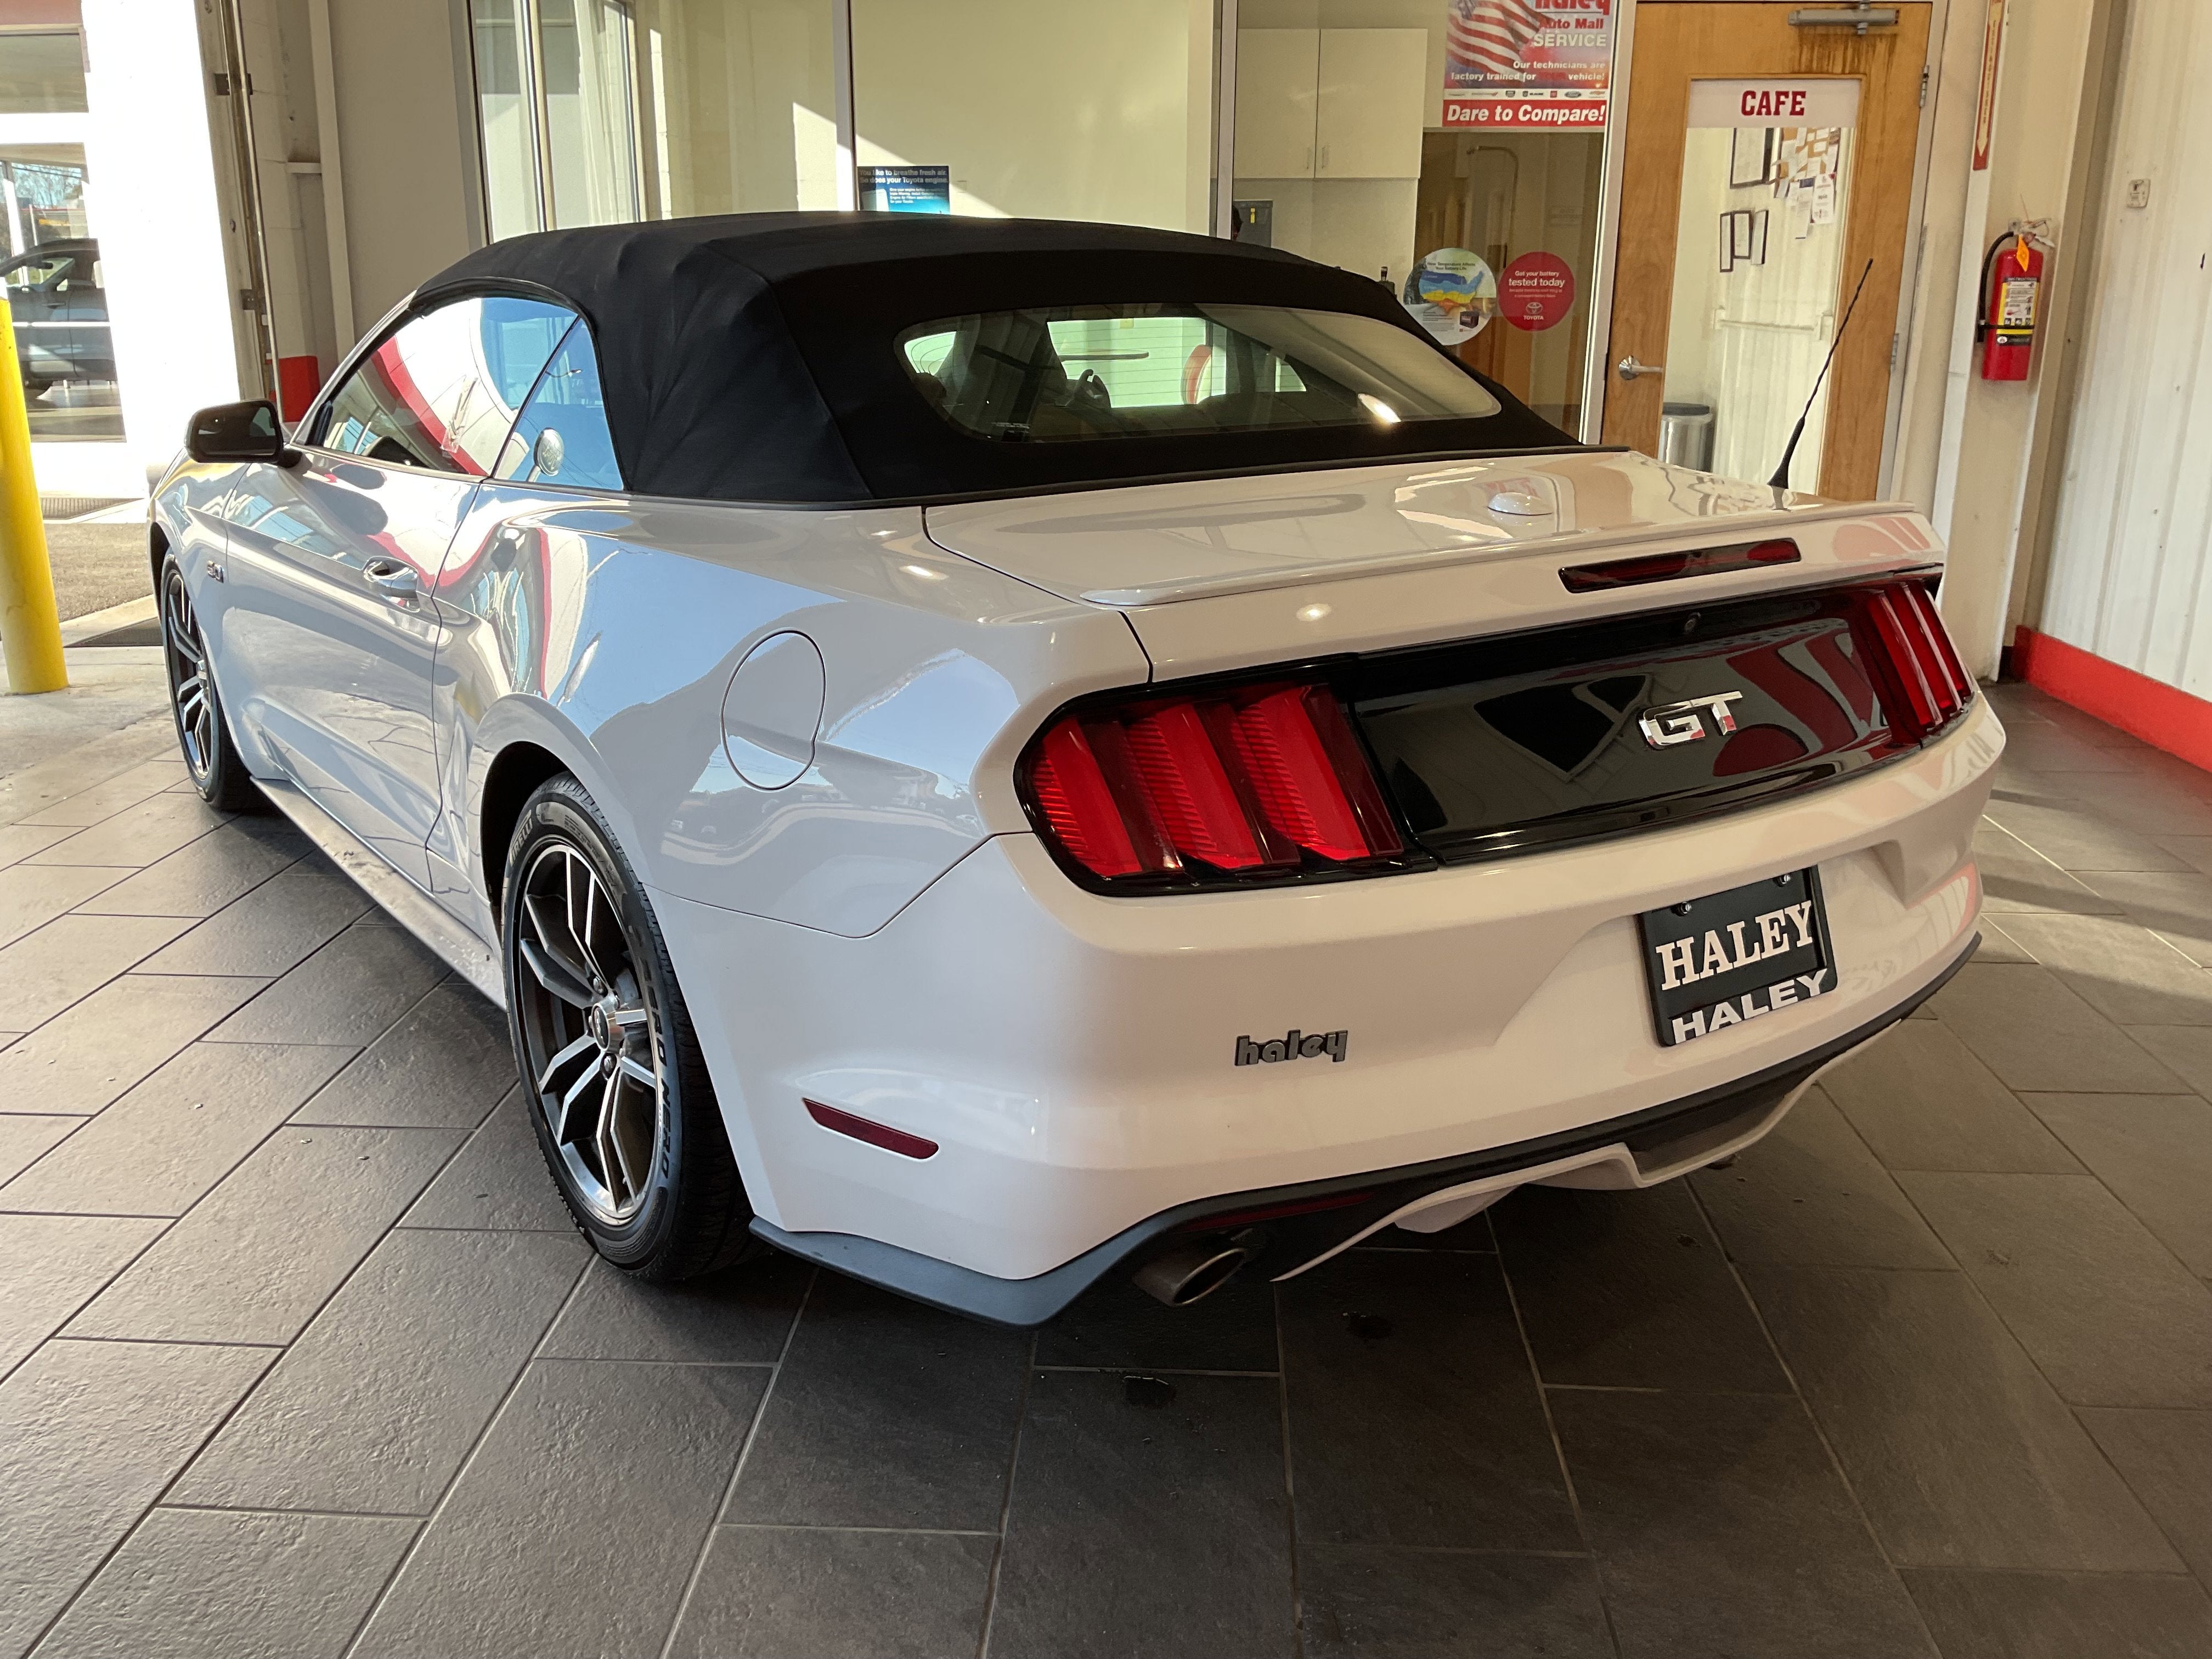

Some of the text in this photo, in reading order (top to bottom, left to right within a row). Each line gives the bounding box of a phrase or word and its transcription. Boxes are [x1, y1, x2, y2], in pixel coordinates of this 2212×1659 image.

[1575, 18, 1604, 29] Mall
[1533, 33, 1607, 47] SERVICE
[1533, 60, 1587, 69] technicians
[1451, 72, 1484, 82] factory
[1522, 72, 1536, 82] for
[1741, 90, 1807, 116] CAFE
[1447, 104, 1606, 126] Dare to Compare!
[902, 176, 924, 185] Toyota
[1509, 278, 1565, 288] tested today
[1639, 690, 1743, 751] GT
[1655, 900, 1813, 991] HALEY
[1672, 968, 1828, 1044] HALEY
[1234, 1029, 1348, 1066] haley
